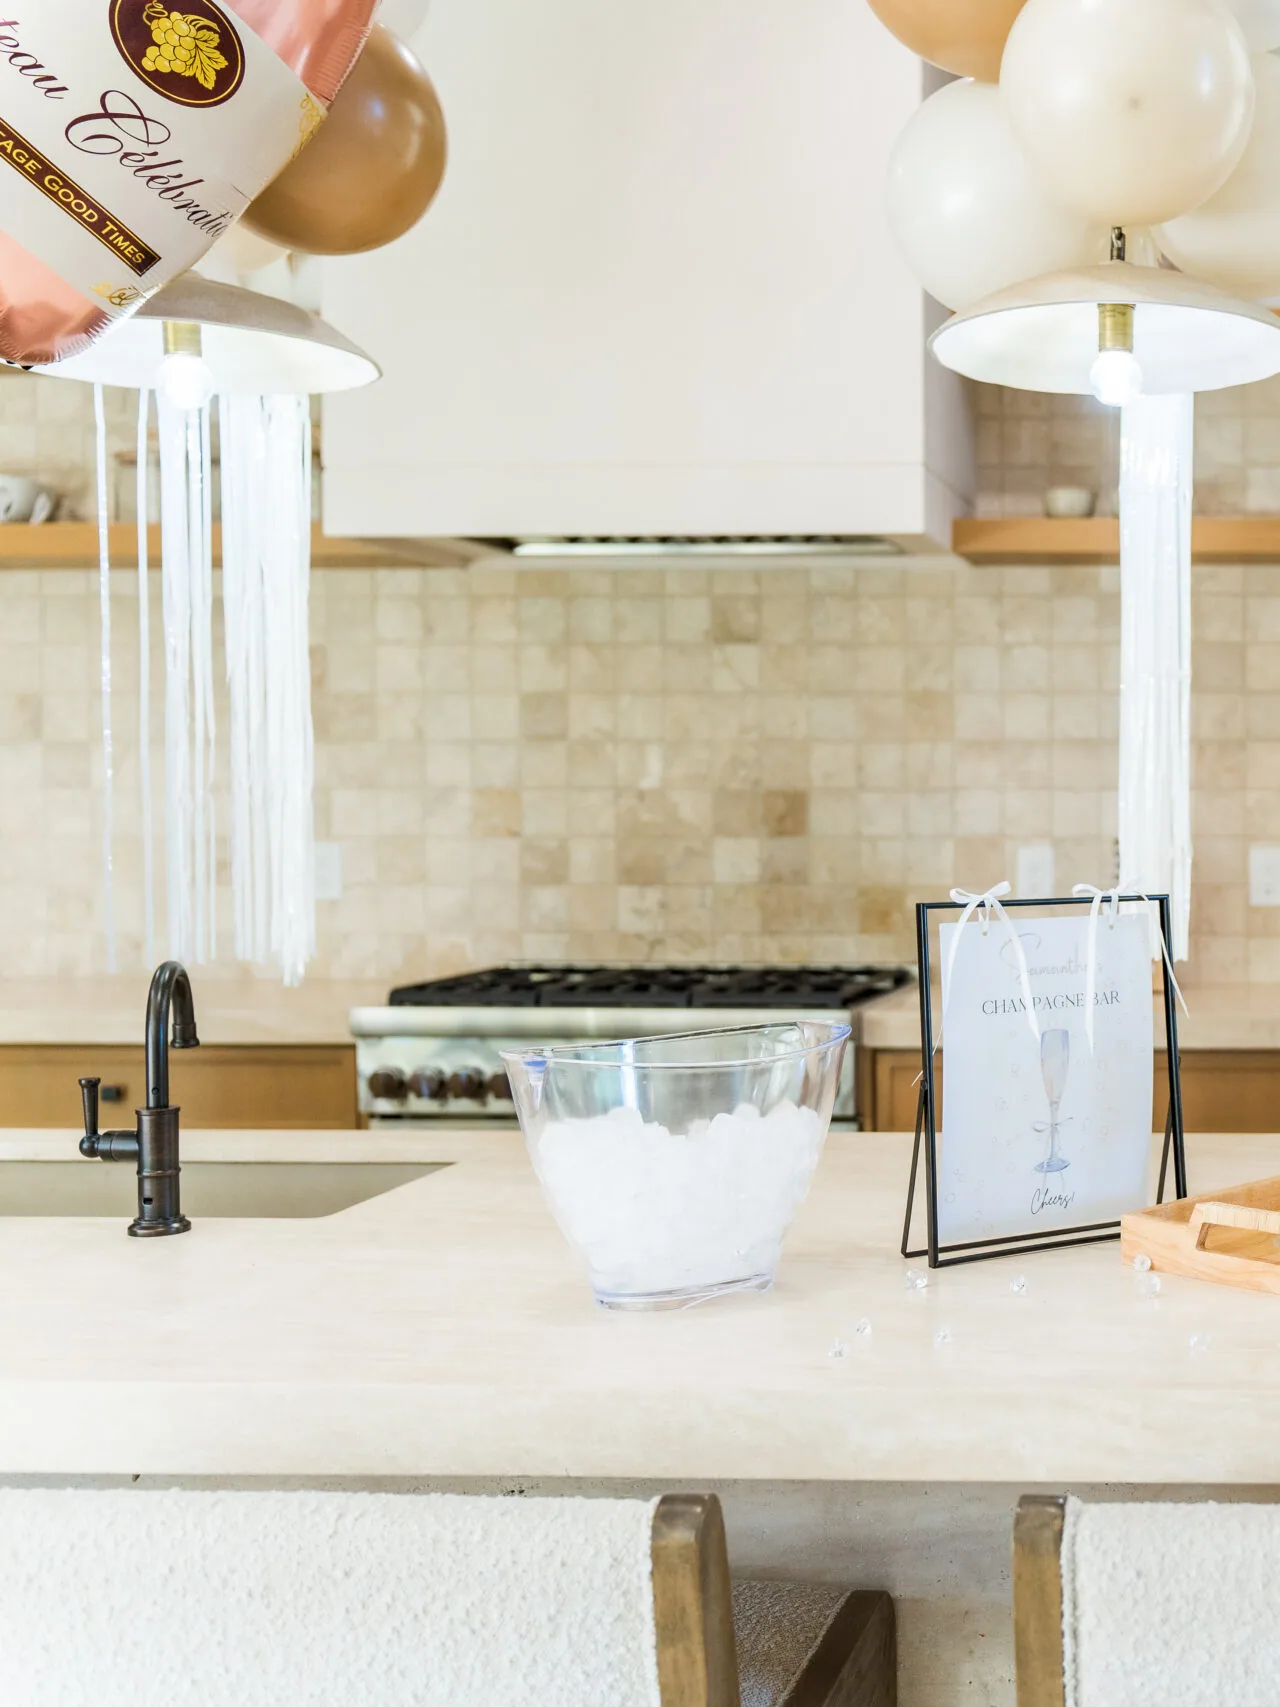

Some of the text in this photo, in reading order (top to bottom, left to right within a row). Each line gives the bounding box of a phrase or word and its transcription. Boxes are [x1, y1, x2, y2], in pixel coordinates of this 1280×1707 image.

[0, 131, 145, 264] AGE GOOD TIMES
